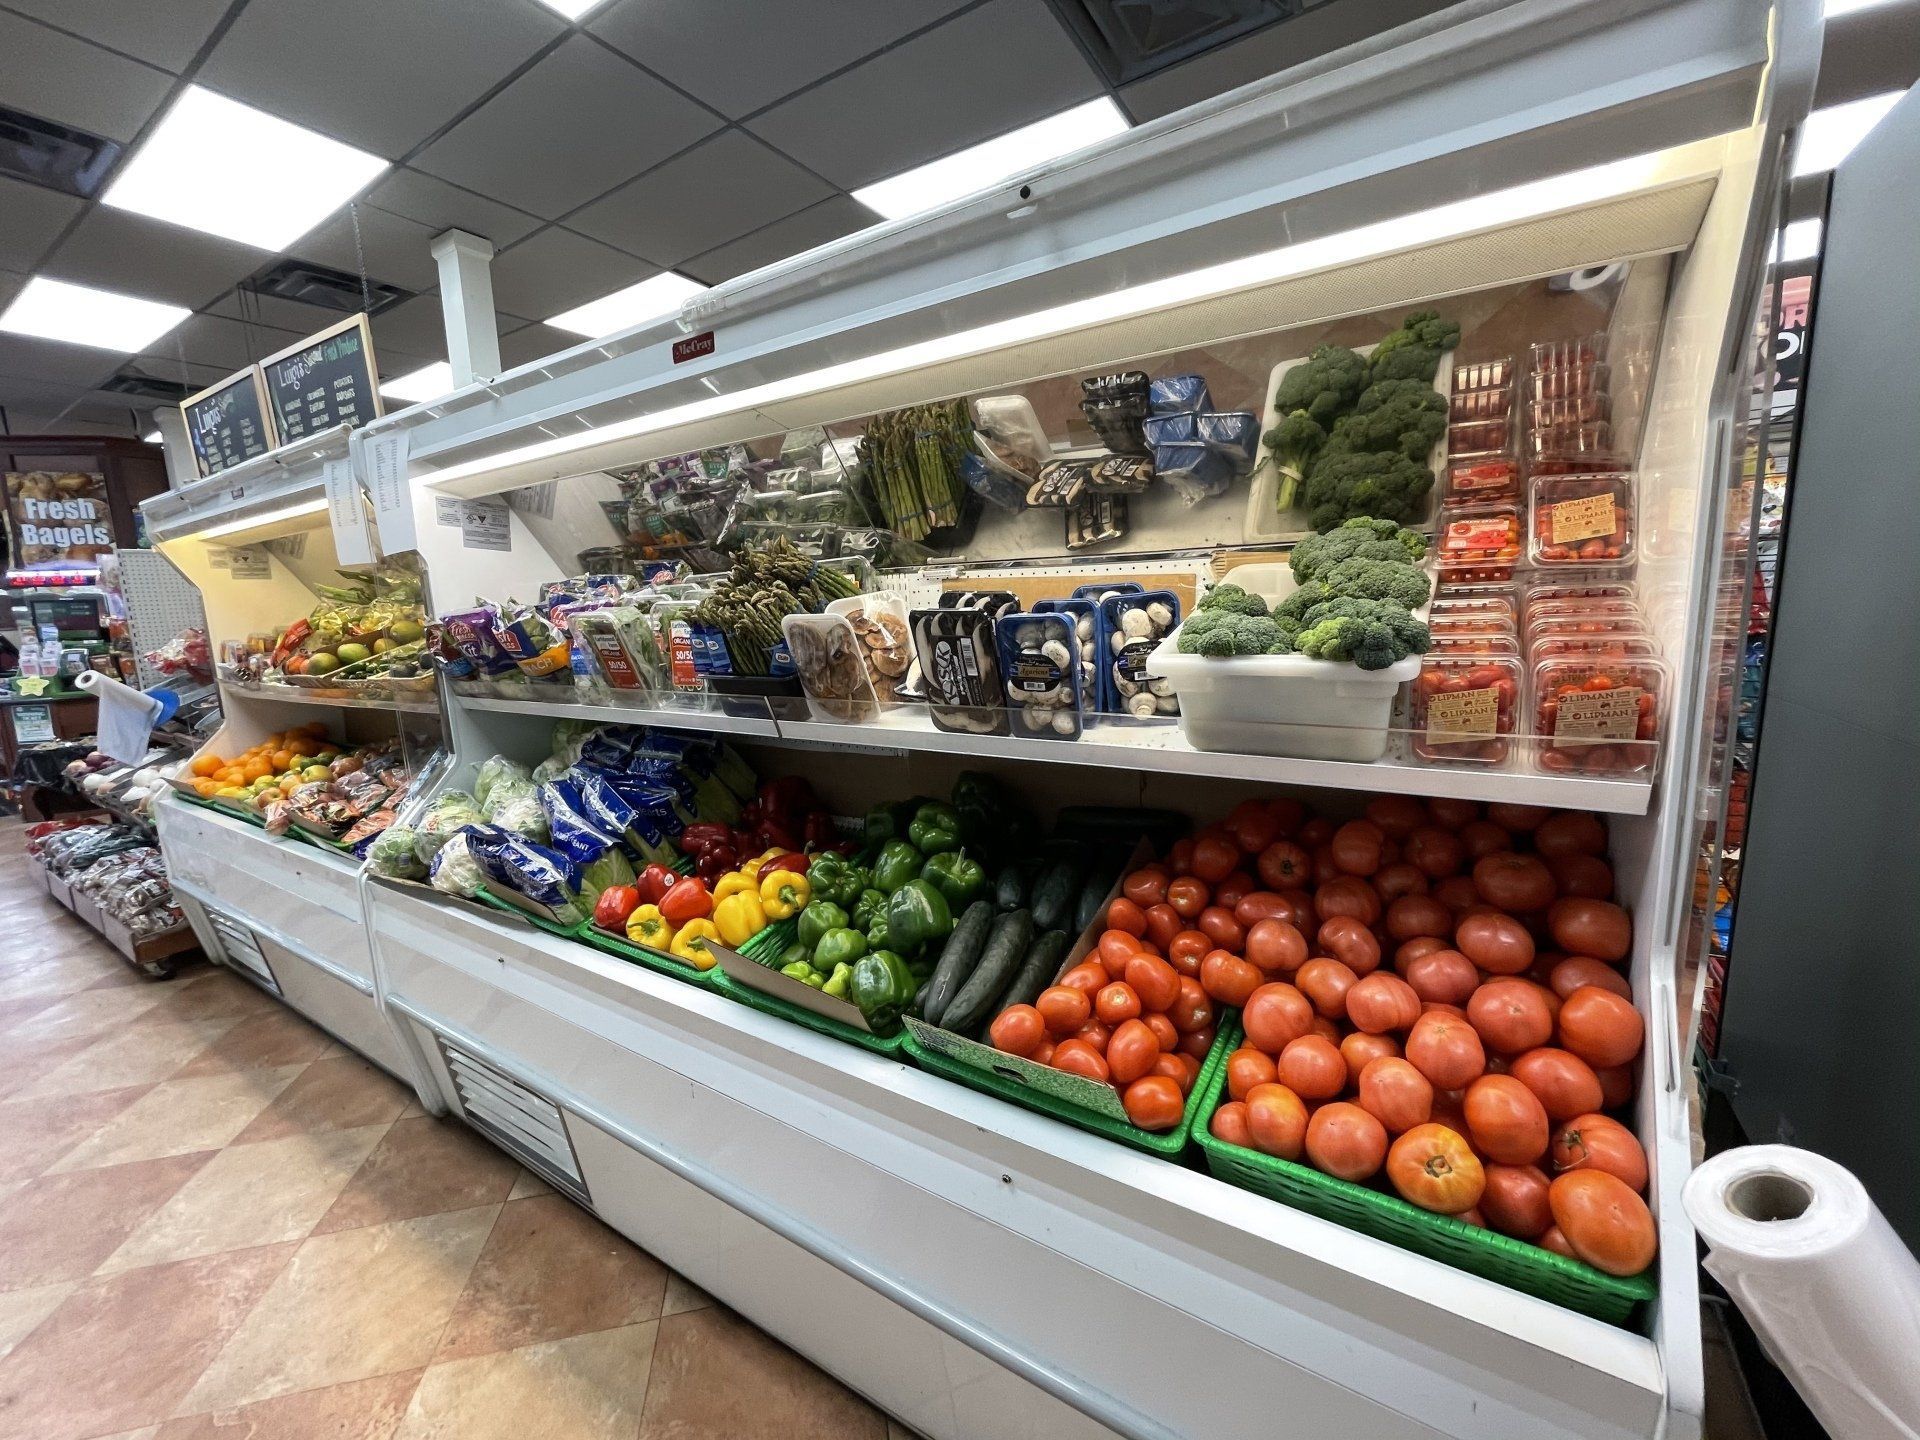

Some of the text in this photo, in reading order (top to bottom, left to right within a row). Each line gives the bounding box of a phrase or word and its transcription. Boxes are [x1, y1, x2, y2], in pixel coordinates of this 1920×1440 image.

[24, 498, 96, 519] Fresh
[1560, 499, 1594, 509] LIPMAN
[1573, 510, 1607, 520] LIPMAN
[20, 523, 110, 548] Bagels
[1437, 691, 1475, 702] LIPMAN
[1569, 692, 1614, 701] LIPMAN
[1450, 707, 1488, 717] LIPMAN
[1583, 709, 1628, 719] LIPMAN
